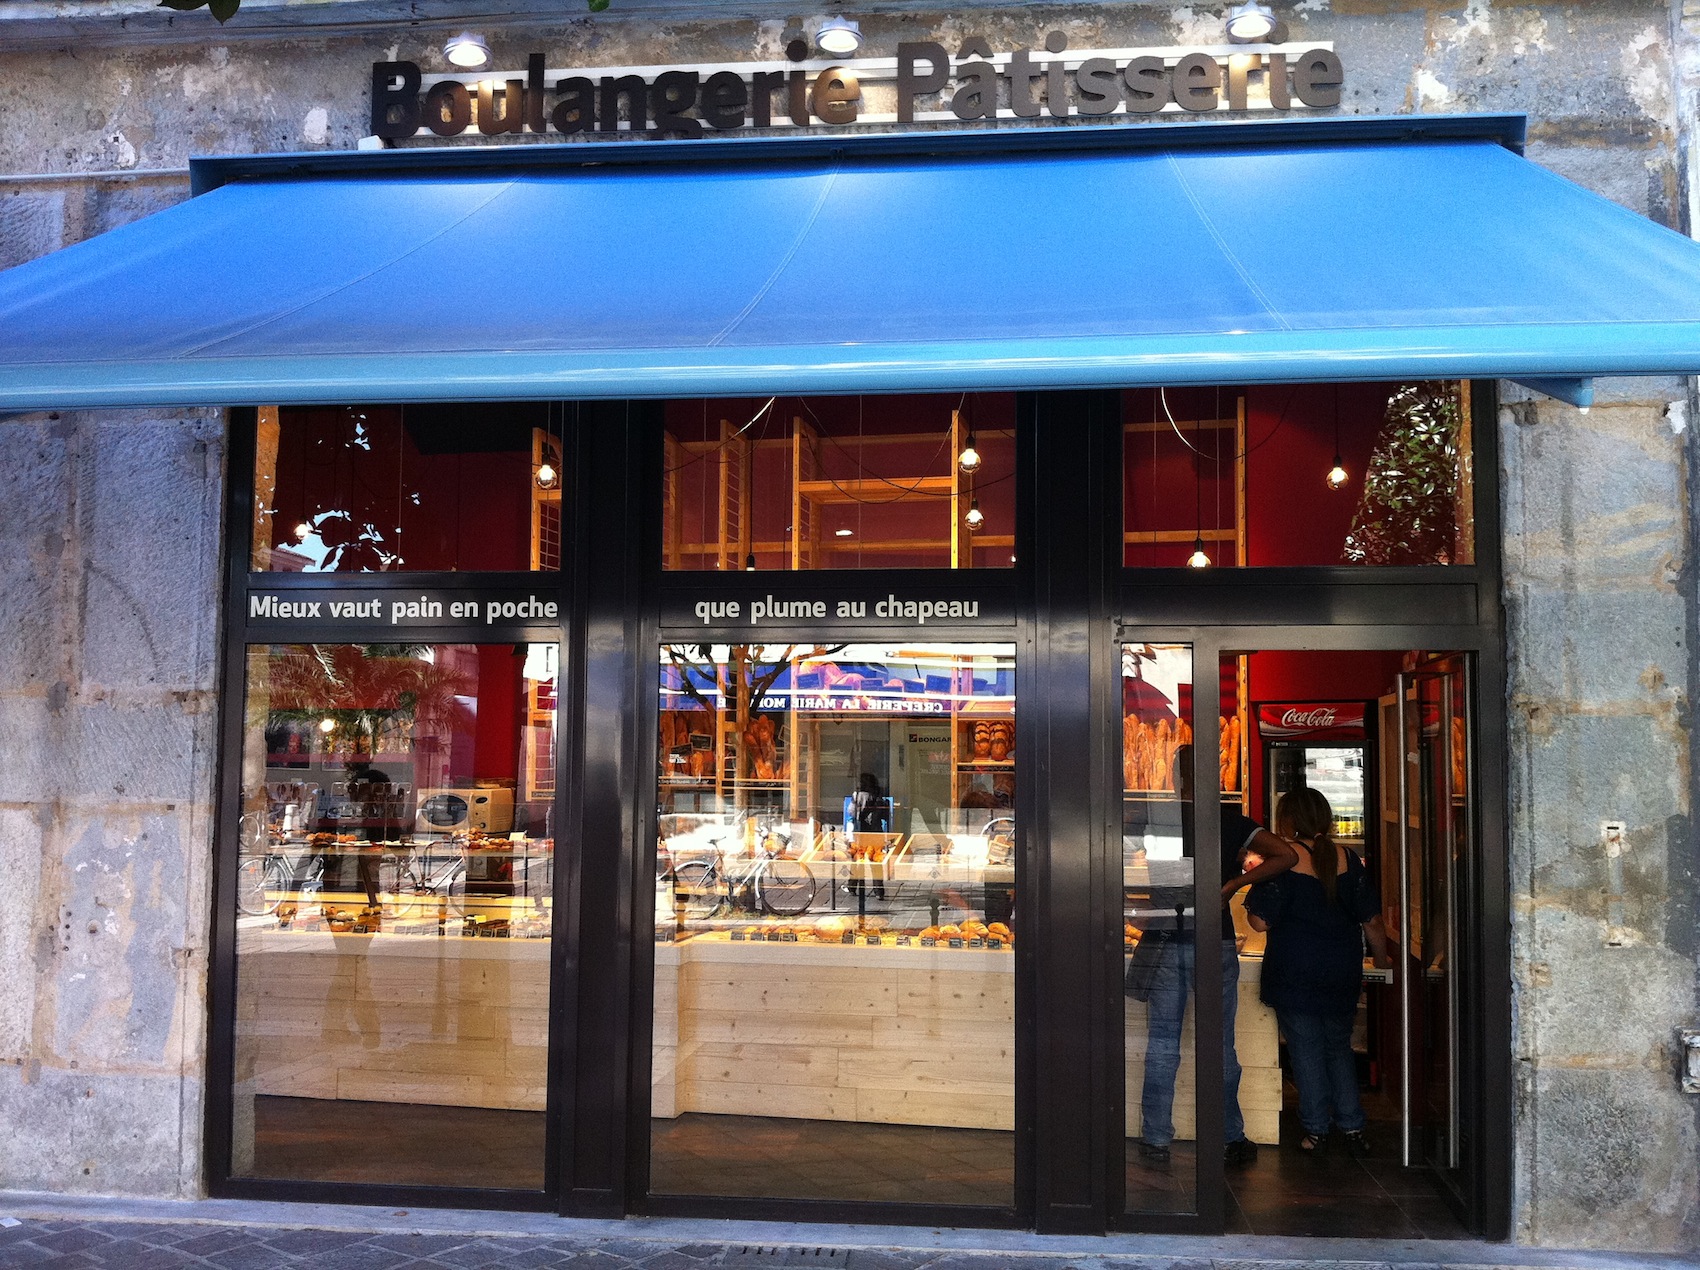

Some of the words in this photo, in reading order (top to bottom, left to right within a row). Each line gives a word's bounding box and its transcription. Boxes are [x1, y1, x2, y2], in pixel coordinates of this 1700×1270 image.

[372, 39, 861, 140] Boulangerie
[897, 22, 1344, 123] Pâtisserie
[250, 595, 322, 618] Mieux
[329, 598, 382, 618] vaut
[392, 596, 443, 624] pain
[450, 600, 478, 618] en
[487, 595, 558, 624] poche
[695, 600, 740, 624] que
[751, 594, 826, 624] plume
[836, 600, 866, 617] au
[875, 594, 979, 624] chapeau
